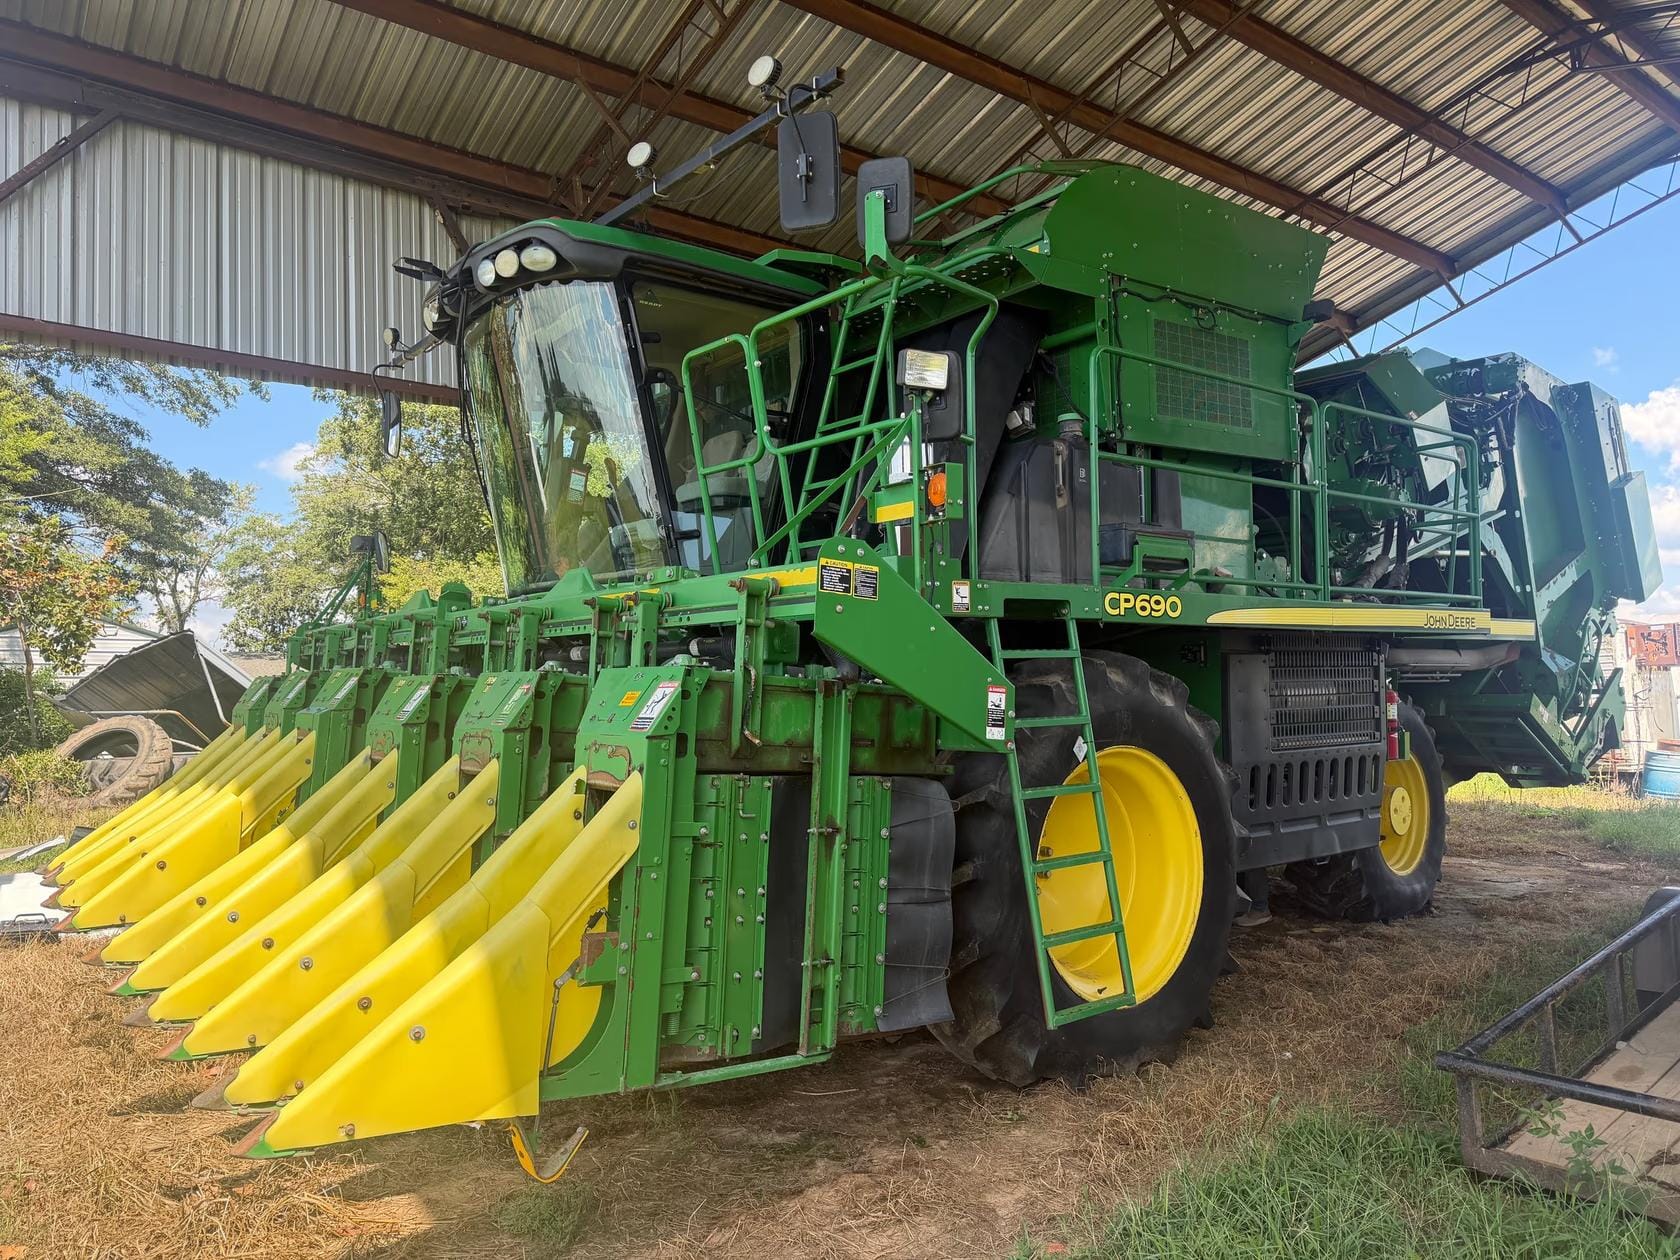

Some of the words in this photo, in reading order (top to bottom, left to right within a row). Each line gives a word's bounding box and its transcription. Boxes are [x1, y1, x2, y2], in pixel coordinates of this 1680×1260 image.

[1104, 591, 1182, 619] CP690
[1424, 612, 1447, 627] JOHN
[1448, 614, 1476, 628] DEERE
